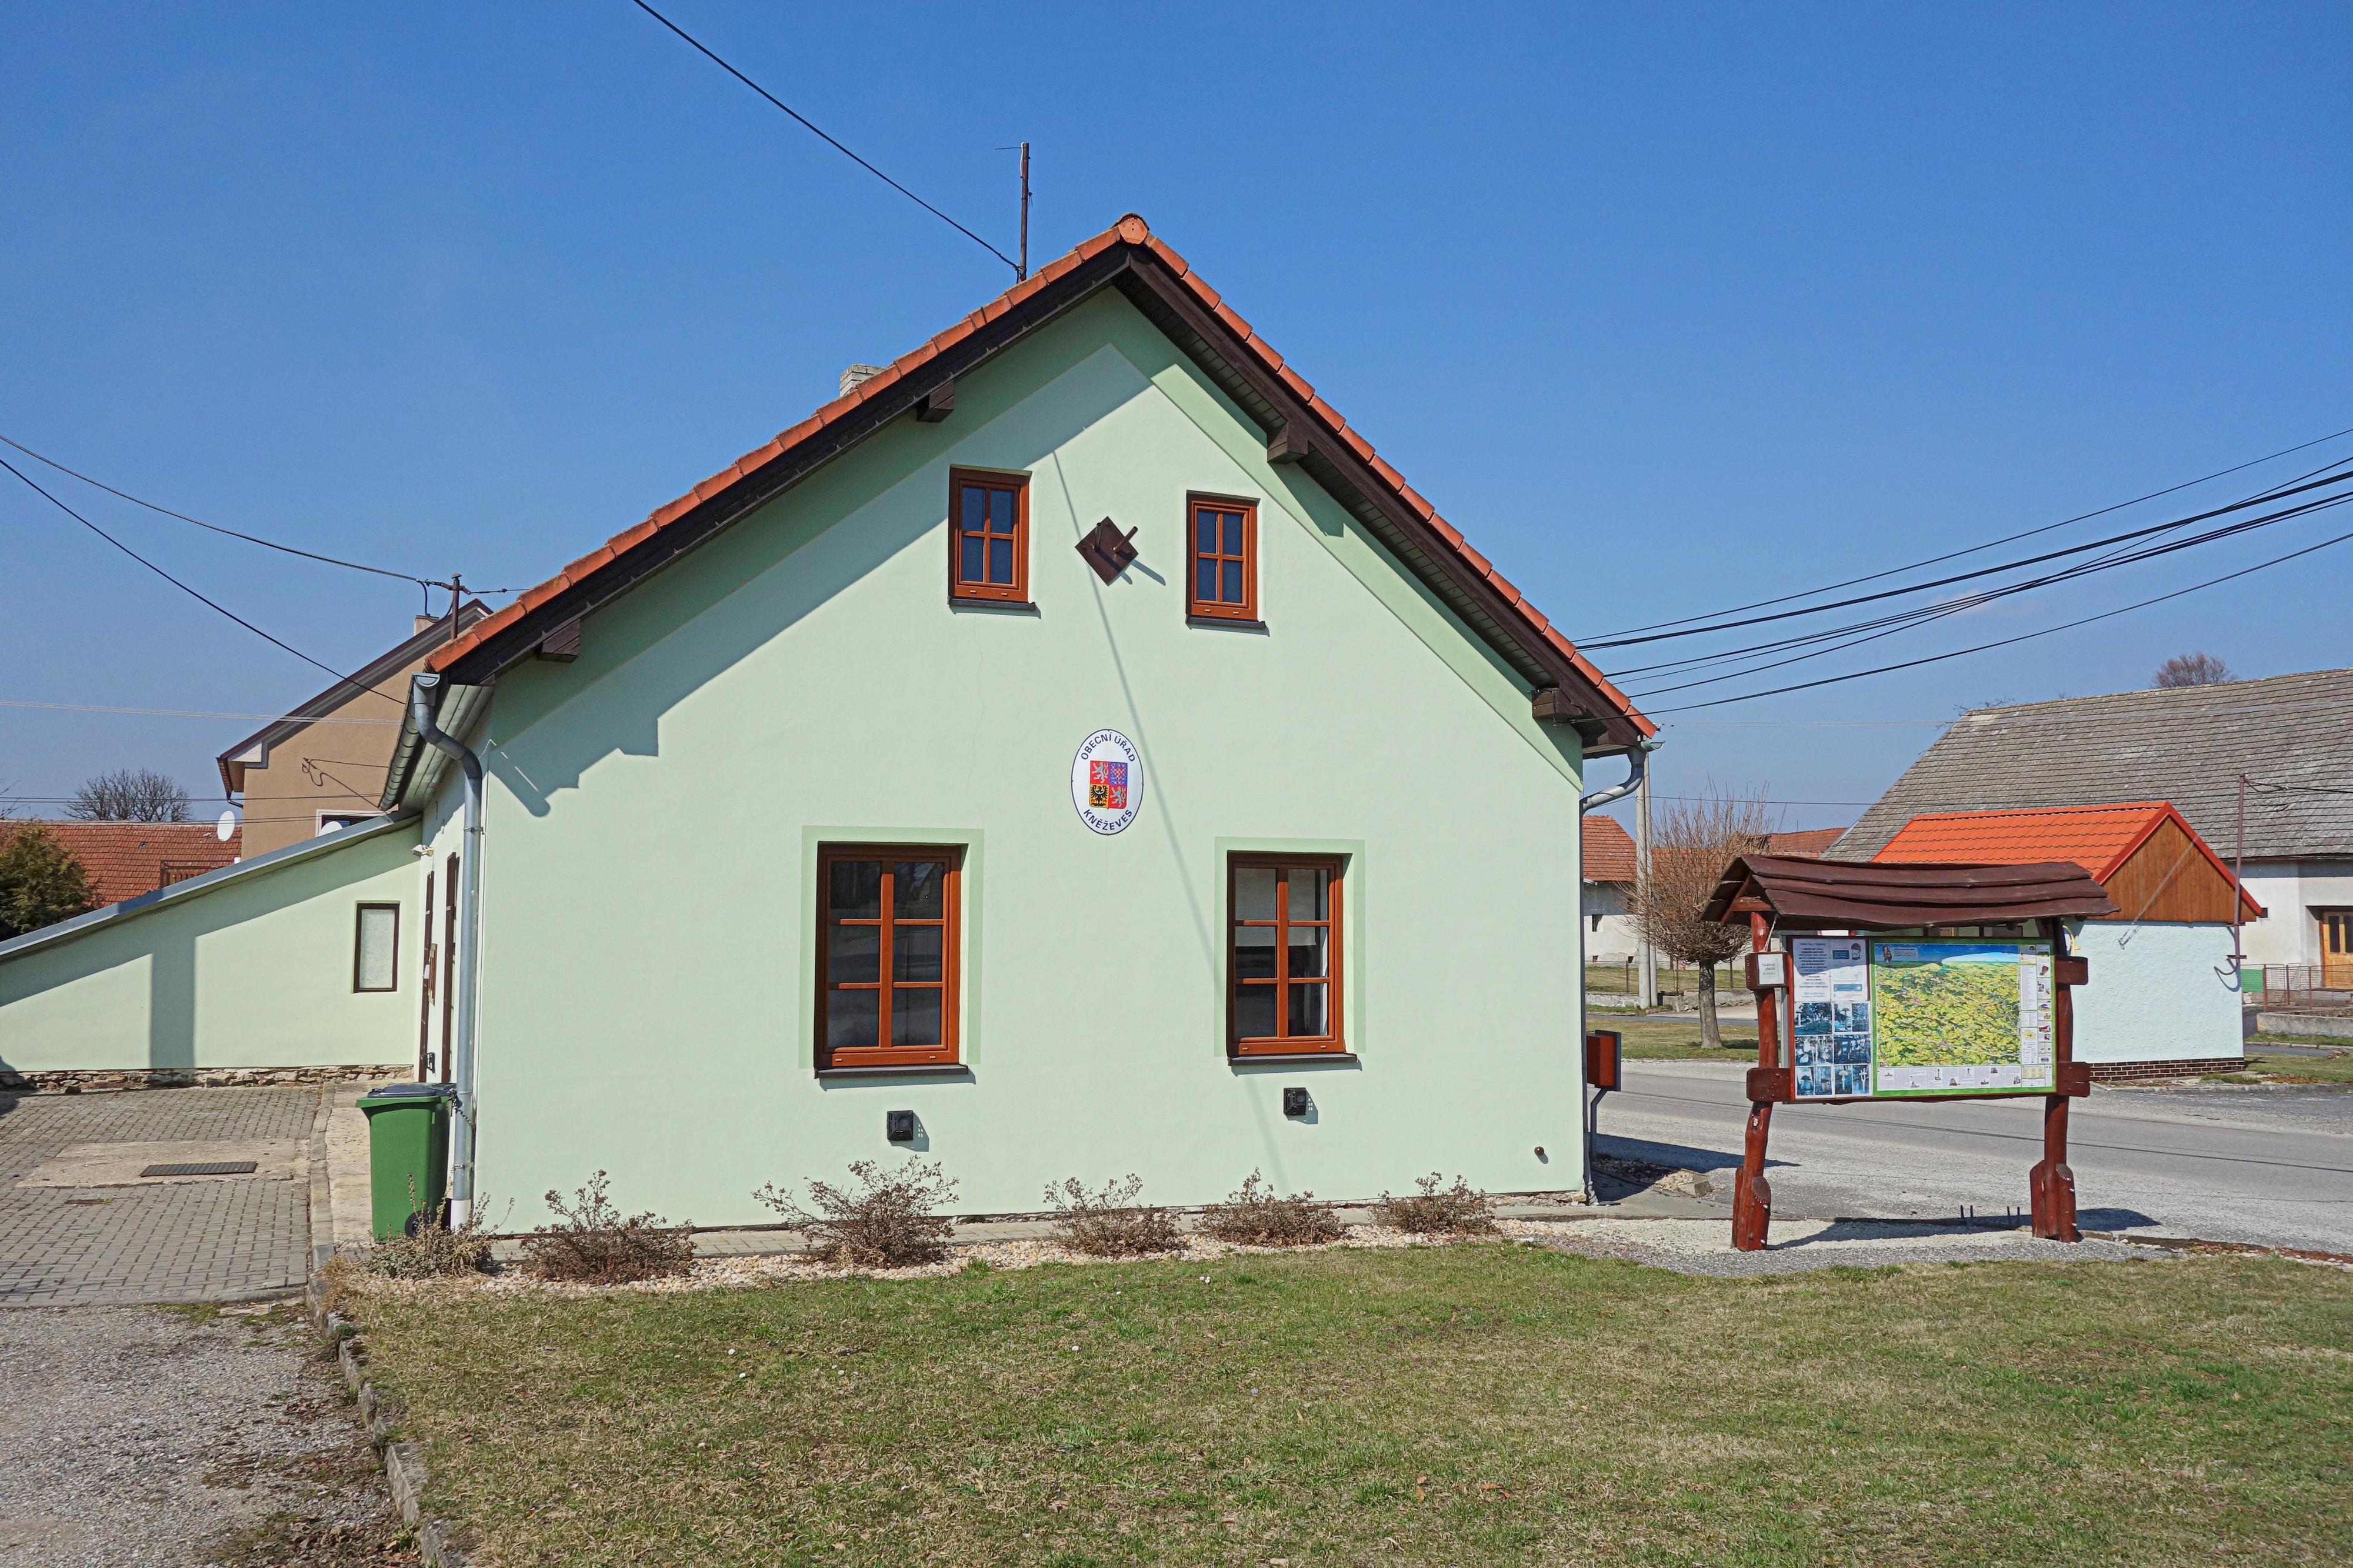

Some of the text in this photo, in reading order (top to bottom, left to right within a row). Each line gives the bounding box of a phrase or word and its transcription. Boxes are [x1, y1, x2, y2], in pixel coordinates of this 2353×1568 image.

[1081, 732, 1135, 762] OBECNÍ ÚŘAD
[1084, 809, 1132, 830] KNĚŽEVES
